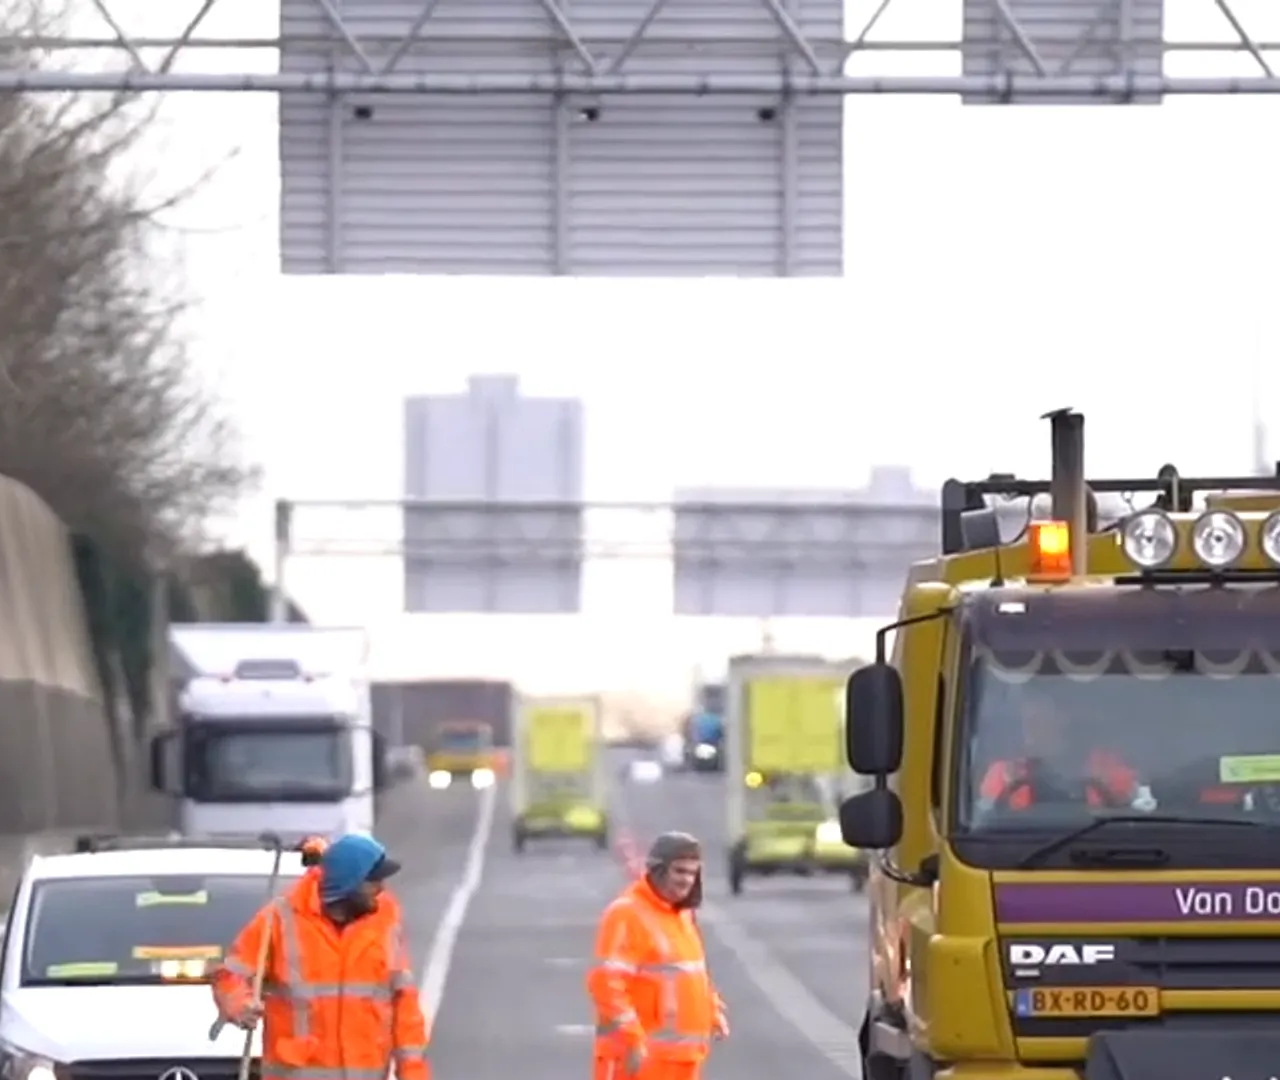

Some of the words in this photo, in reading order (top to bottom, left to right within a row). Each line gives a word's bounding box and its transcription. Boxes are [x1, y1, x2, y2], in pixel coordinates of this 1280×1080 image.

[1175, 887, 1232, 914] Van
[1010, 944, 1115, 965] DAF
[1032, 991, 1148, 1012] BX-RD-60
